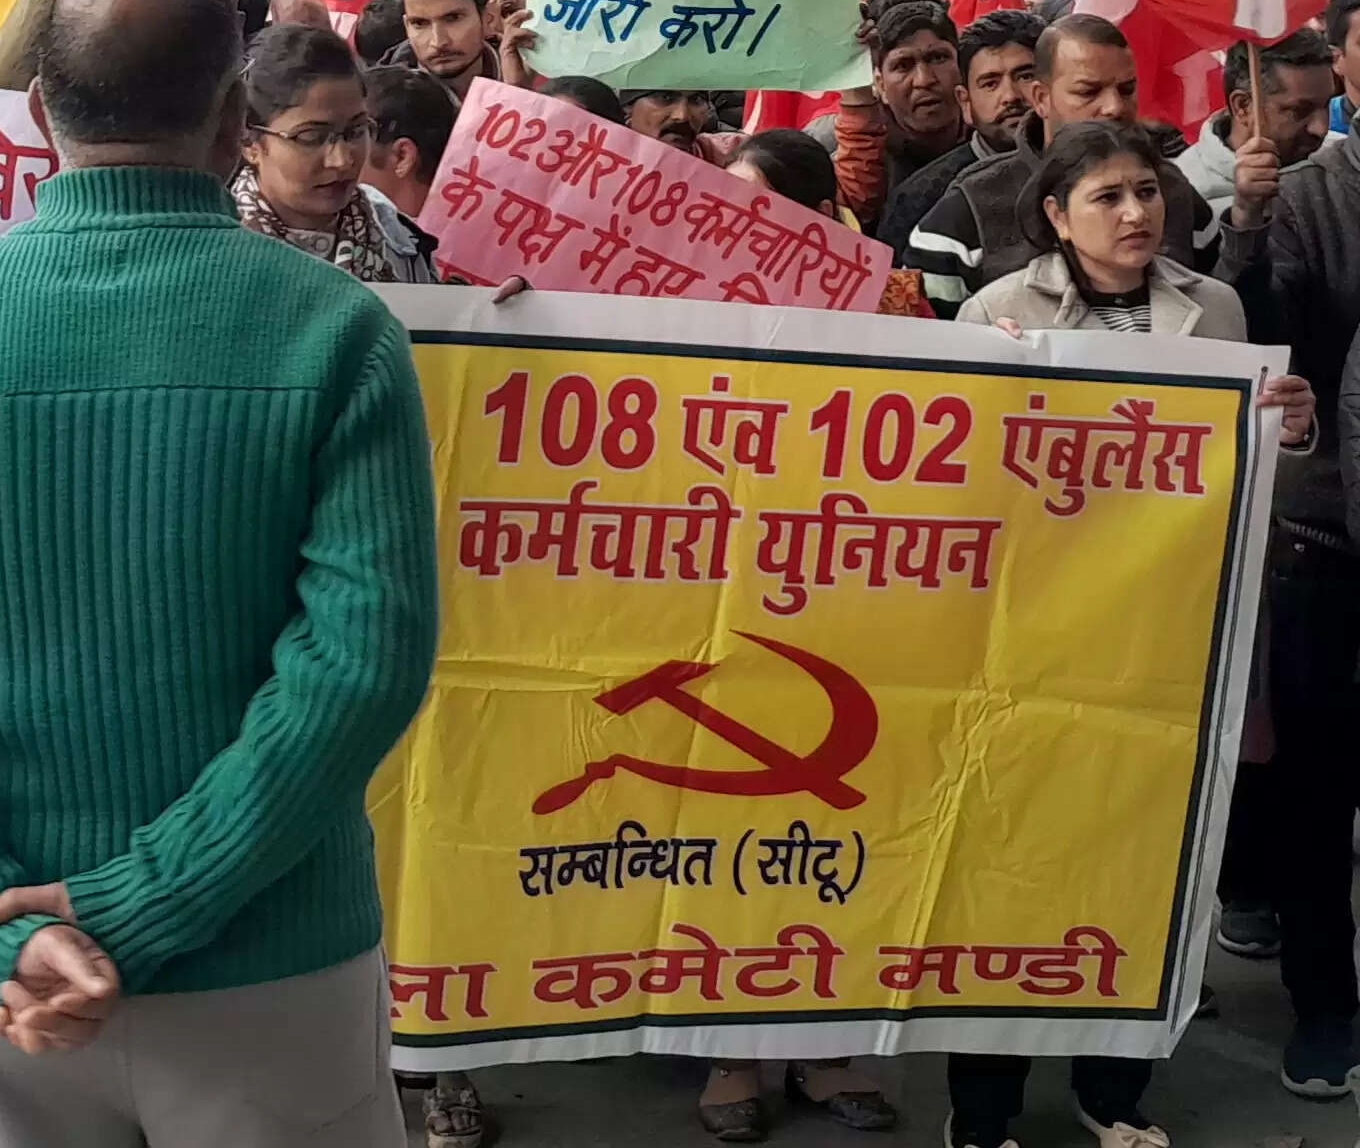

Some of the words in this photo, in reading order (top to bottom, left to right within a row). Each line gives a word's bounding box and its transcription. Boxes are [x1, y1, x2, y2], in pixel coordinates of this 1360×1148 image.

[441, 155, 496, 221] के
[493, 187, 586, 265] पक्ष
[483, 370, 658, 473] 108
[682, 376, 790, 477] एंव
[807, 389, 973, 485] 102
[457, 479, 741, 581] कर्मचारी
[756, 492, 1003, 617] युनियन
[518, 819, 717, 899] सम्बन्धित
[732, 819, 869, 906] (सीटू)
[532, 922, 844, 1011] कमेटी
[877, 924, 1128, 999] मण्डी
